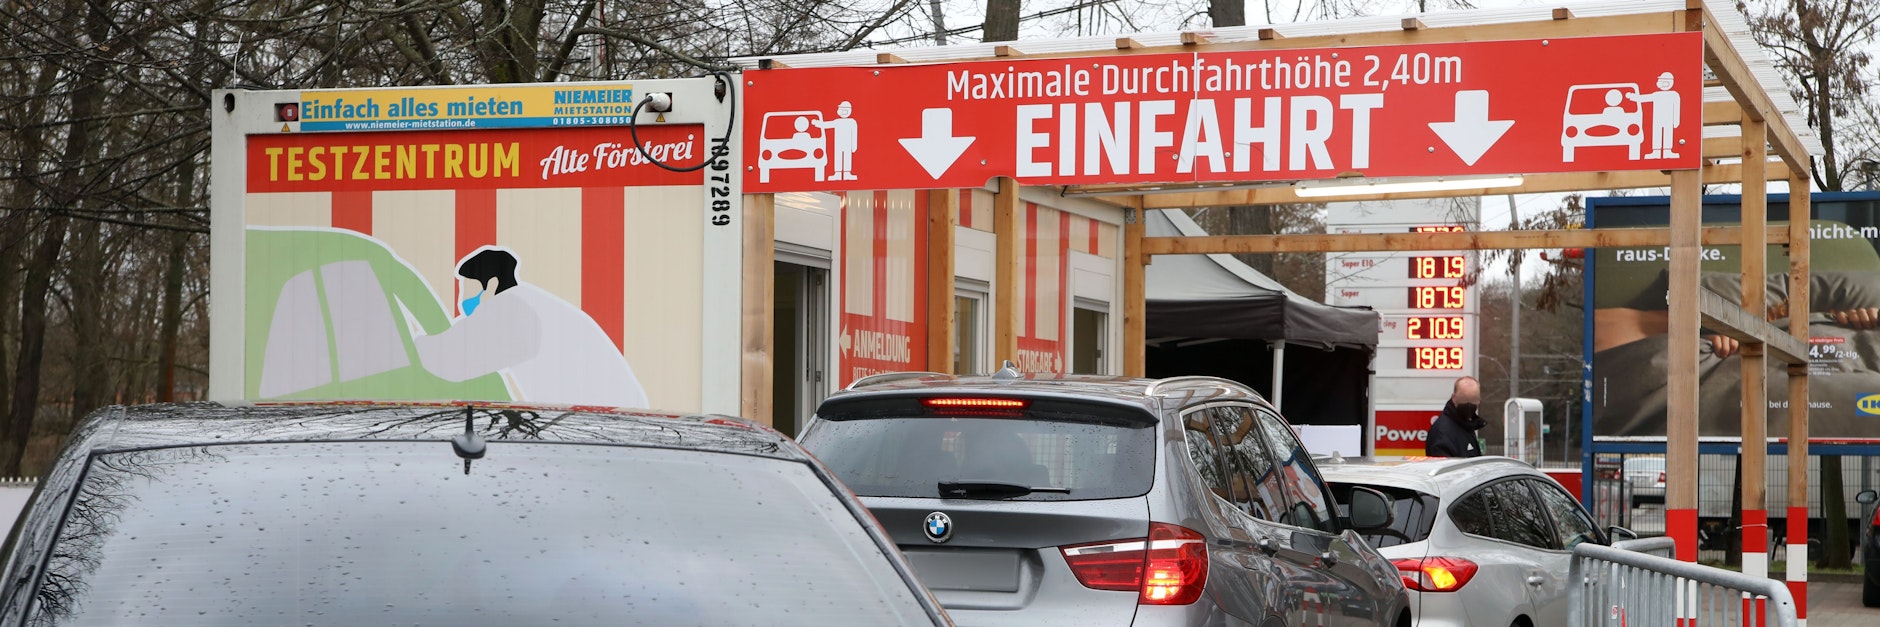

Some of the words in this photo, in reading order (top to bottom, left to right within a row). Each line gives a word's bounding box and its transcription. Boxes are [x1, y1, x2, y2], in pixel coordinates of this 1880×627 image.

[947, 64, 1090, 100] Maximale
[1103, 55, 1351, 95] Durchfahrthöhe
[1364, 53, 1462, 91] 2,40m
[554, 89, 632, 104] NIEMEIER
[302, 98, 379, 119] Einfach
[388, 97, 438, 117] alles
[447, 96, 523, 116] mieten
[554, 105, 632, 115] MIETSTATION
[345, 119, 475, 130] www.niemeier-mietstation.de
[552, 116, 632, 126] 01805-308050
[1016, 93, 1384, 177] EINFAHRT
[265, 142, 521, 181] TESTZENTRUM
[540, 145, 588, 180] Alte
[593, 134, 694, 170] Försterei
[711, 138, 731, 226] 1097289
[1809, 224, 1880, 239] nicht-m
[1341, 260, 1359, 269] Super
[1362, 259, 1374, 268] E10
[1416, 257, 1465, 279] 181.9
[1341, 289, 1359, 298] Super
[1416, 287, 1464, 309] 187.9
[853, 329, 911, 363] ANMELDUNG
[1415, 347, 1463, 369] 198.9
[1769, 400, 1781, 408] bei
[1376, 425, 1428, 441] Powe
